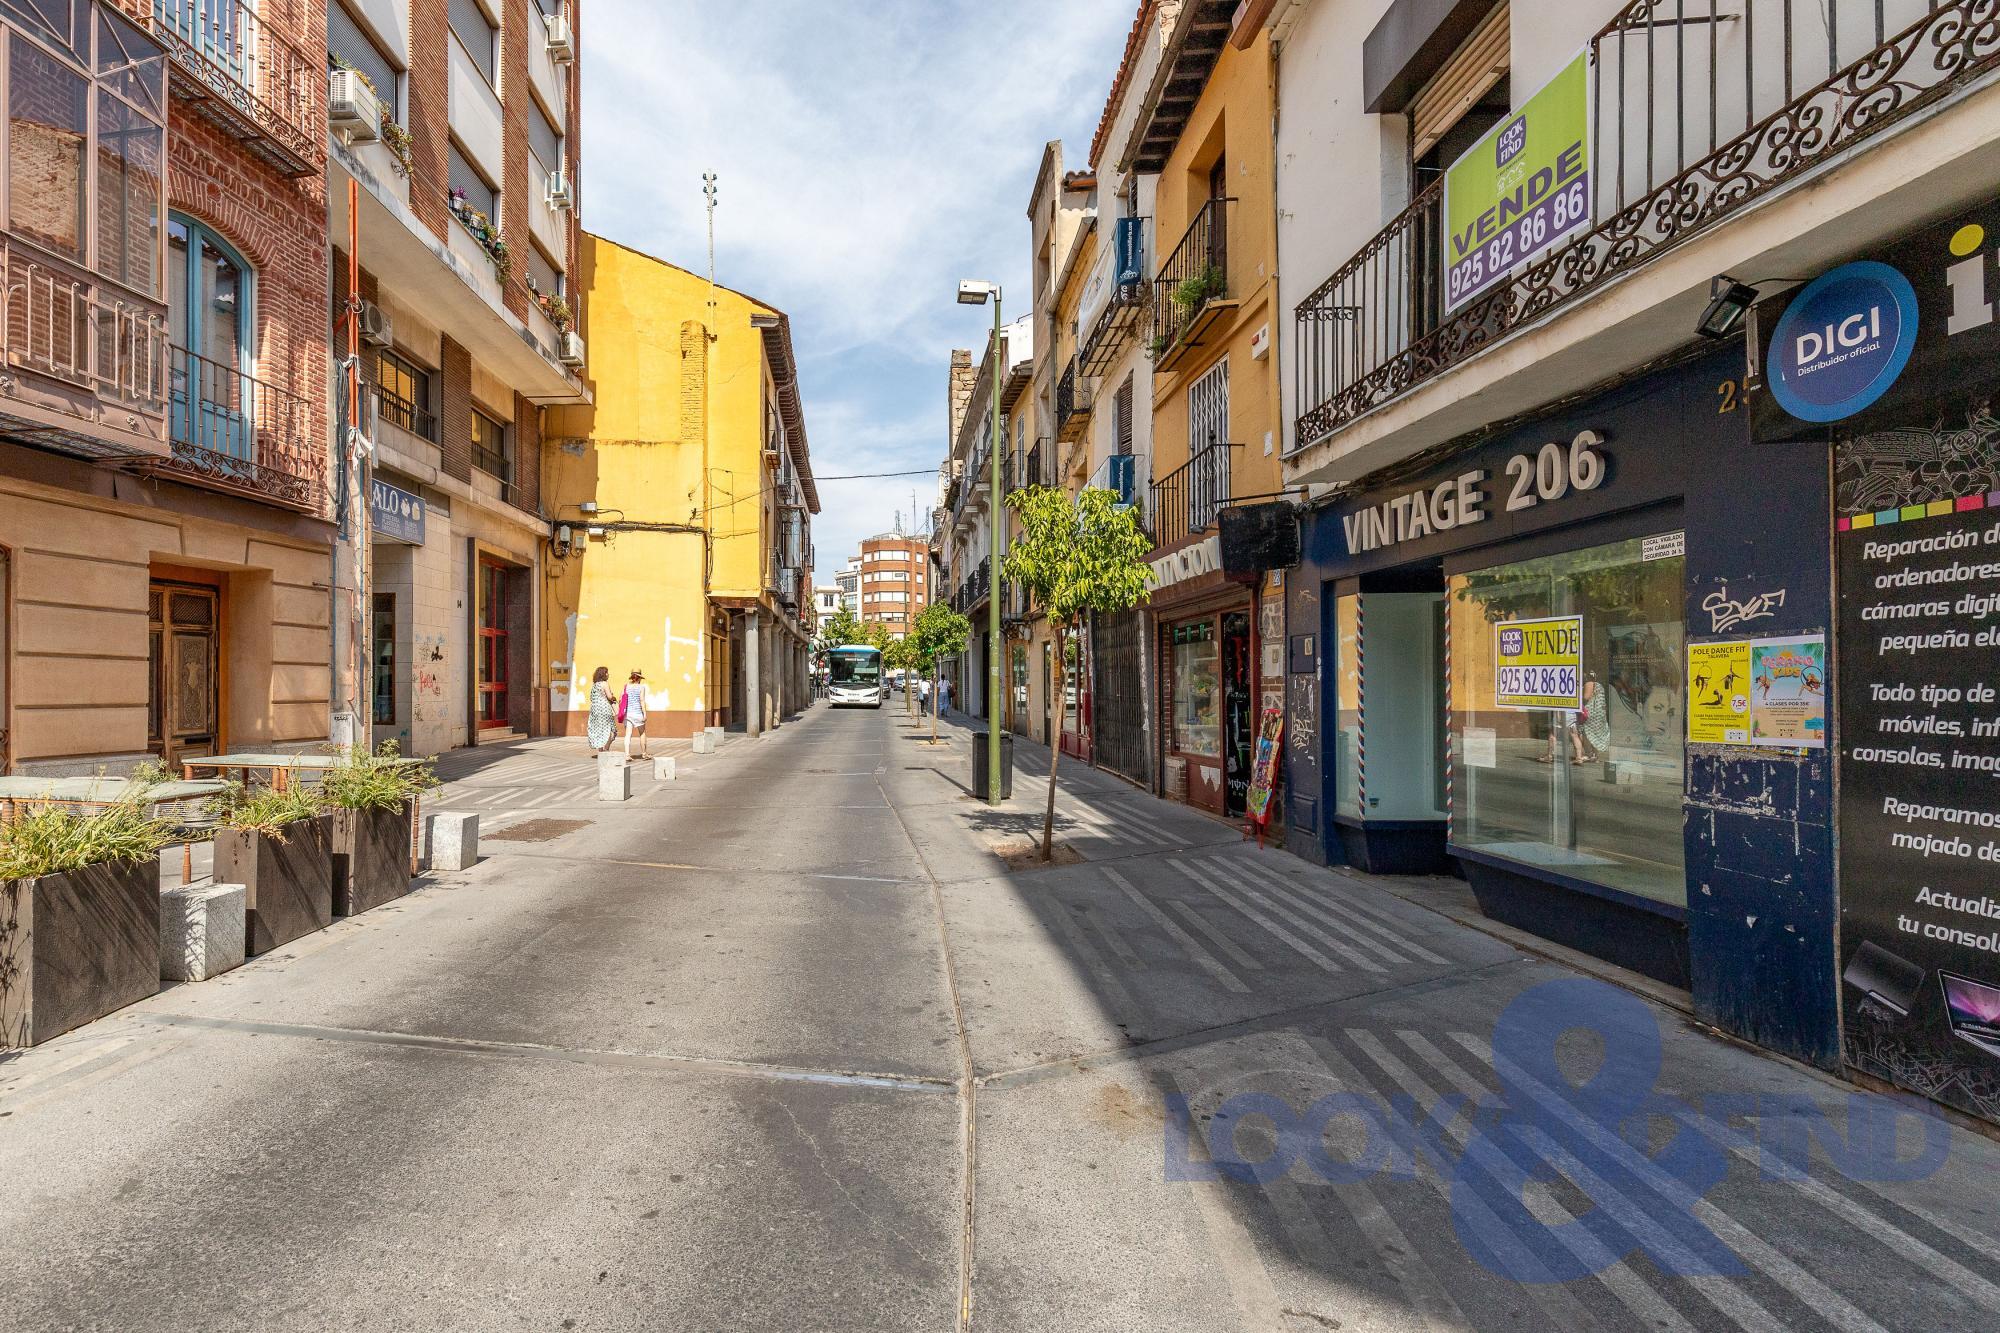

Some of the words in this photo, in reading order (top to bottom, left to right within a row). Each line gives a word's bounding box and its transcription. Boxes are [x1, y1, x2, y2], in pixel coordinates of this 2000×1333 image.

[1499, 119, 1524, 149] LOOK
[1499, 138, 1523, 164] FIND
[1453, 140, 1582, 256] VENDE
[1451, 251, 1483, 299] 925
[1488, 231, 1514, 273] 82
[1519, 207, 1546, 253] 86
[1553, 182, 1584, 229] 86
[1946, 224, 2000, 335] i
[1796, 306, 1880, 366] DIGI
[1797, 353, 1849, 377] Distribuidor
[1850, 341, 1880, 358] oficial
[1343, 470, 1485, 554] VINTAGE
[1505, 430, 1605, 512] 206
[1660, 533, 1683, 543] VIGILADO
[1863, 529, 1979, 562] Reparación
[1984, 523, 2000, 545] d
[1644, 550, 1670, 560] SEGURIDAD
[1862, 599, 1950, 621] cámaras
[1502, 631, 1522, 641] LOOK
[1503, 644, 1520, 653] FIND
[1524, 628, 1578, 656] VENDE
[1879, 629, 1970, 655] pequeña
[1711, 646, 1734, 654] DANCE
[1735, 645, 1746, 653] FIT
[1761, 655, 1814, 669] VERANO
[1501, 667, 1521, 693] 925
[1523, 667, 1538, 693] 82
[1540, 667, 1556, 694] 86
[1558, 667, 1575, 695] 86
[1773, 667, 1801, 680] KIDS
[1731, 699, 1747, 708] 7,5€
[1870, 682, 1916, 701] Todo
[1920, 684, 1961, 708] tipo
[1966, 683, 1996, 703] de
[1879, 715, 1966, 738] móviles,
[1852, 746, 1945, 769] consolas,
[1891, 831, 1973, 858] mojado
[1898, 914, 1919, 934] tu
[1923, 921, 2000, 953] consol
